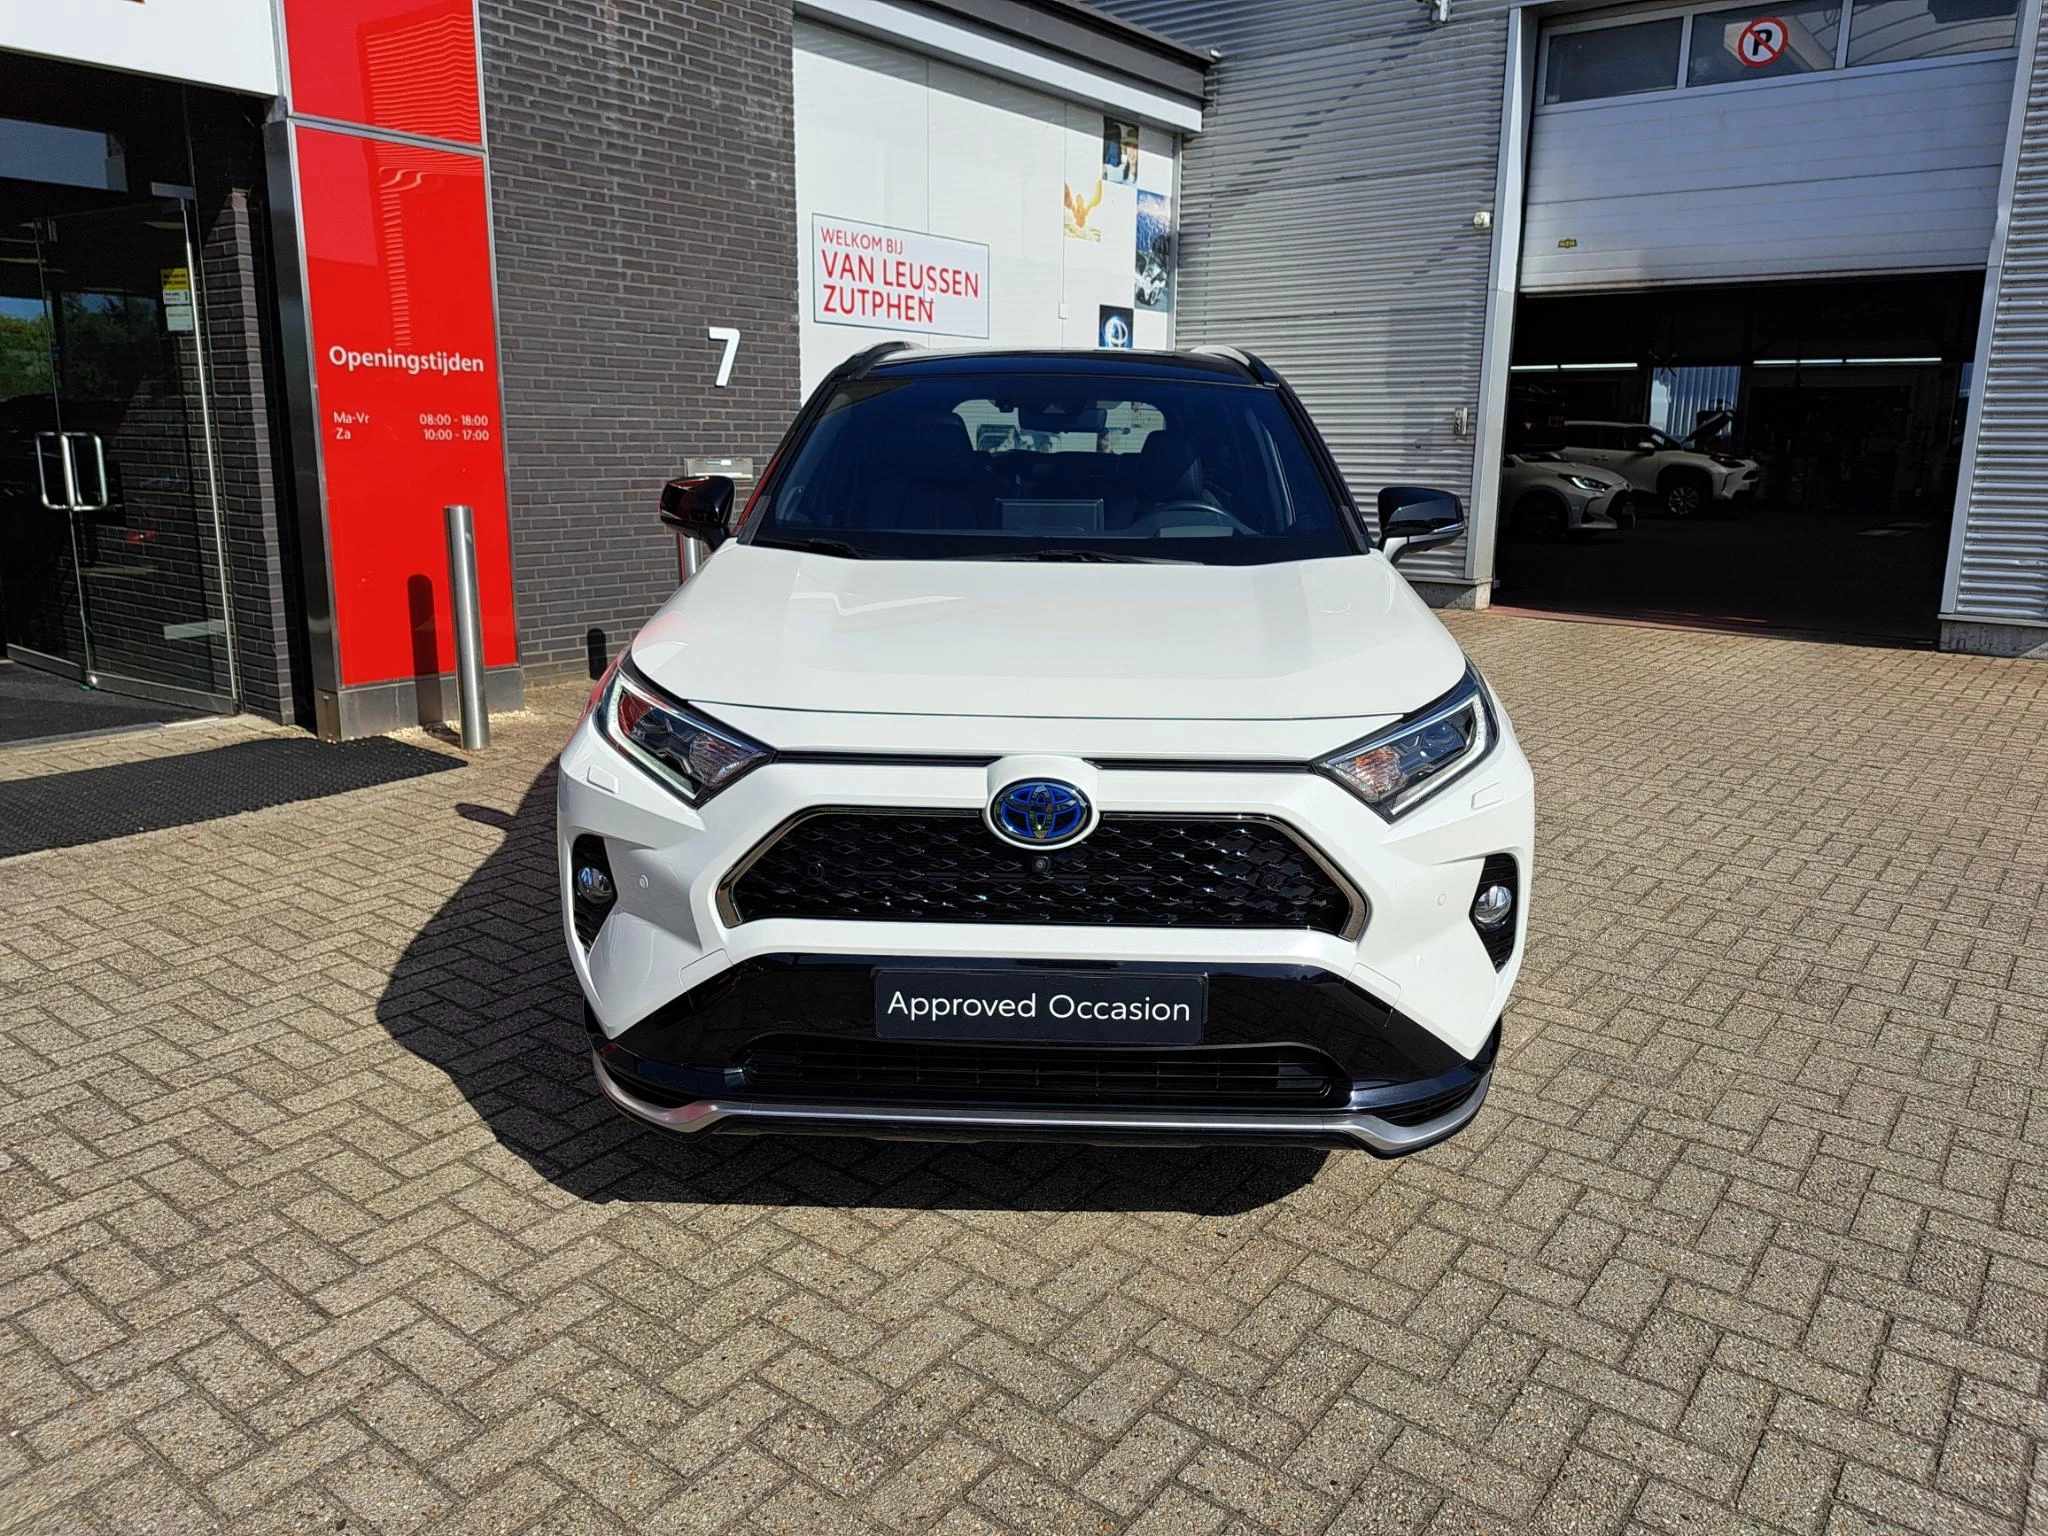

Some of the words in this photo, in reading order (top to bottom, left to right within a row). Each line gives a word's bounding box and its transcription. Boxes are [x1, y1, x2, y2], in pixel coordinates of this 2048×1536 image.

[1752, 29, 1773, 56] P
[821, 227, 882, 252] WELKOM
[886, 238, 903, 255] BIJ
[821, 249, 874, 284] VAN
[883, 258, 979, 298] LEUSSEN
[823, 284, 934, 323] ZUTPHEN
[329, 345, 484, 376] Openingstijden
[708, 326, 741, 387] 7
[333, 411, 370, 424] Ma-Vr
[419, 413, 451, 426] 08:00
[461, 414, 489, 427] 18:00
[336, 427, 351, 440] Za
[424, 428, 453, 441] 10:00
[463, 429, 490, 441] 17:00
[887, 990, 1037, 1021] Approved
[1049, 993, 1190, 1021] Occasion
